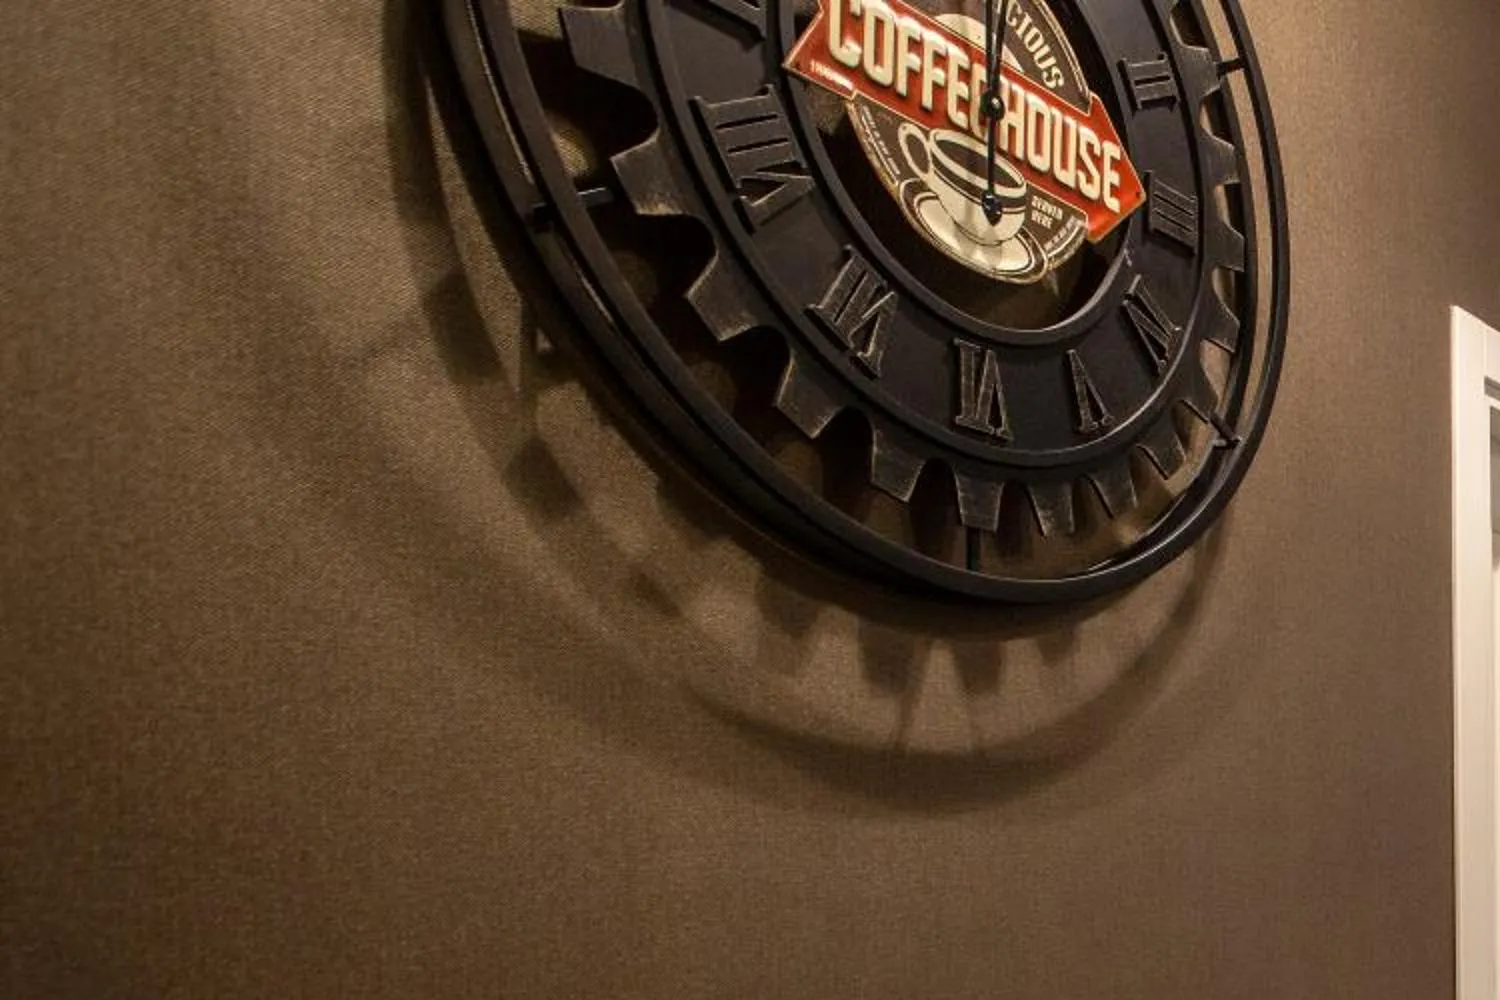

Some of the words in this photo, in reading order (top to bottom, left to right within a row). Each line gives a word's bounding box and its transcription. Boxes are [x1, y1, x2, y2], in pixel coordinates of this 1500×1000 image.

[828, 0, 990, 141] COFFEE
[999, 74, 1122, 213] HOUSE
[996, 0, 1064, 89] CIOUS
